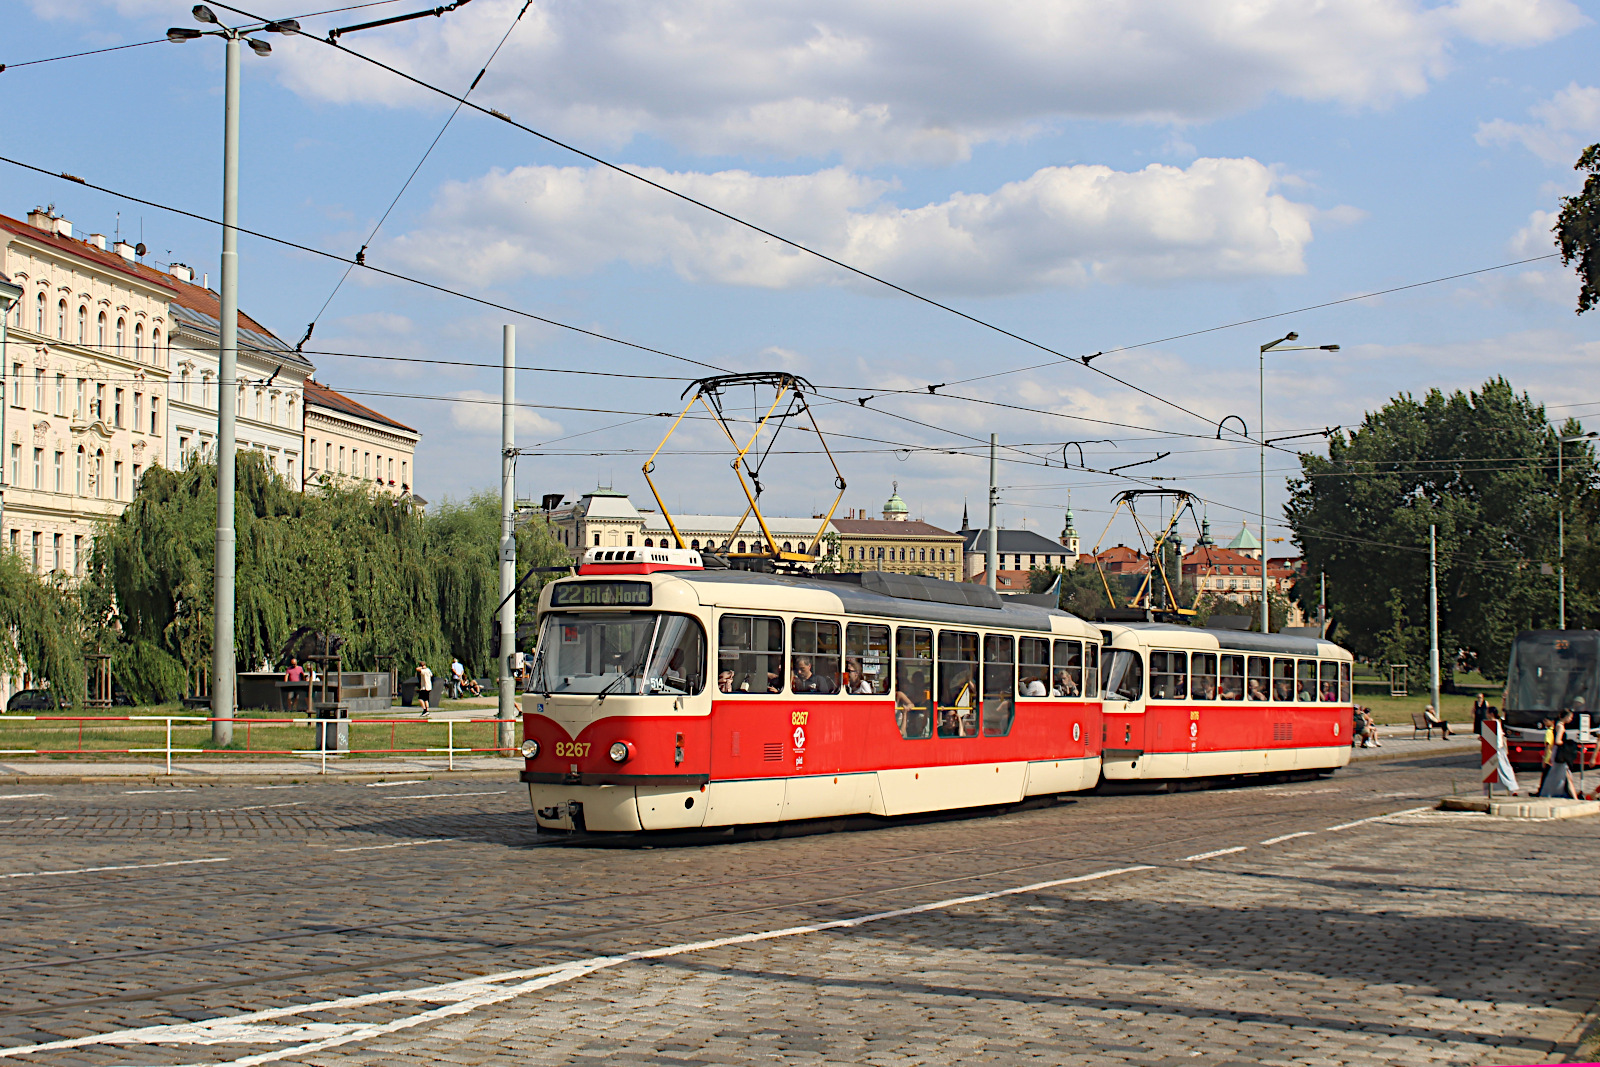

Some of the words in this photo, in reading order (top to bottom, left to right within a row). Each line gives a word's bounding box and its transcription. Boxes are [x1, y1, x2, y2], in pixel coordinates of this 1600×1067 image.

[558, 585, 581, 604] 22
[615, 586, 647, 603] Hora
[650, 677, 664, 689] 514
[792, 711, 809, 725] 8267
[555, 741, 591, 757] 8267
